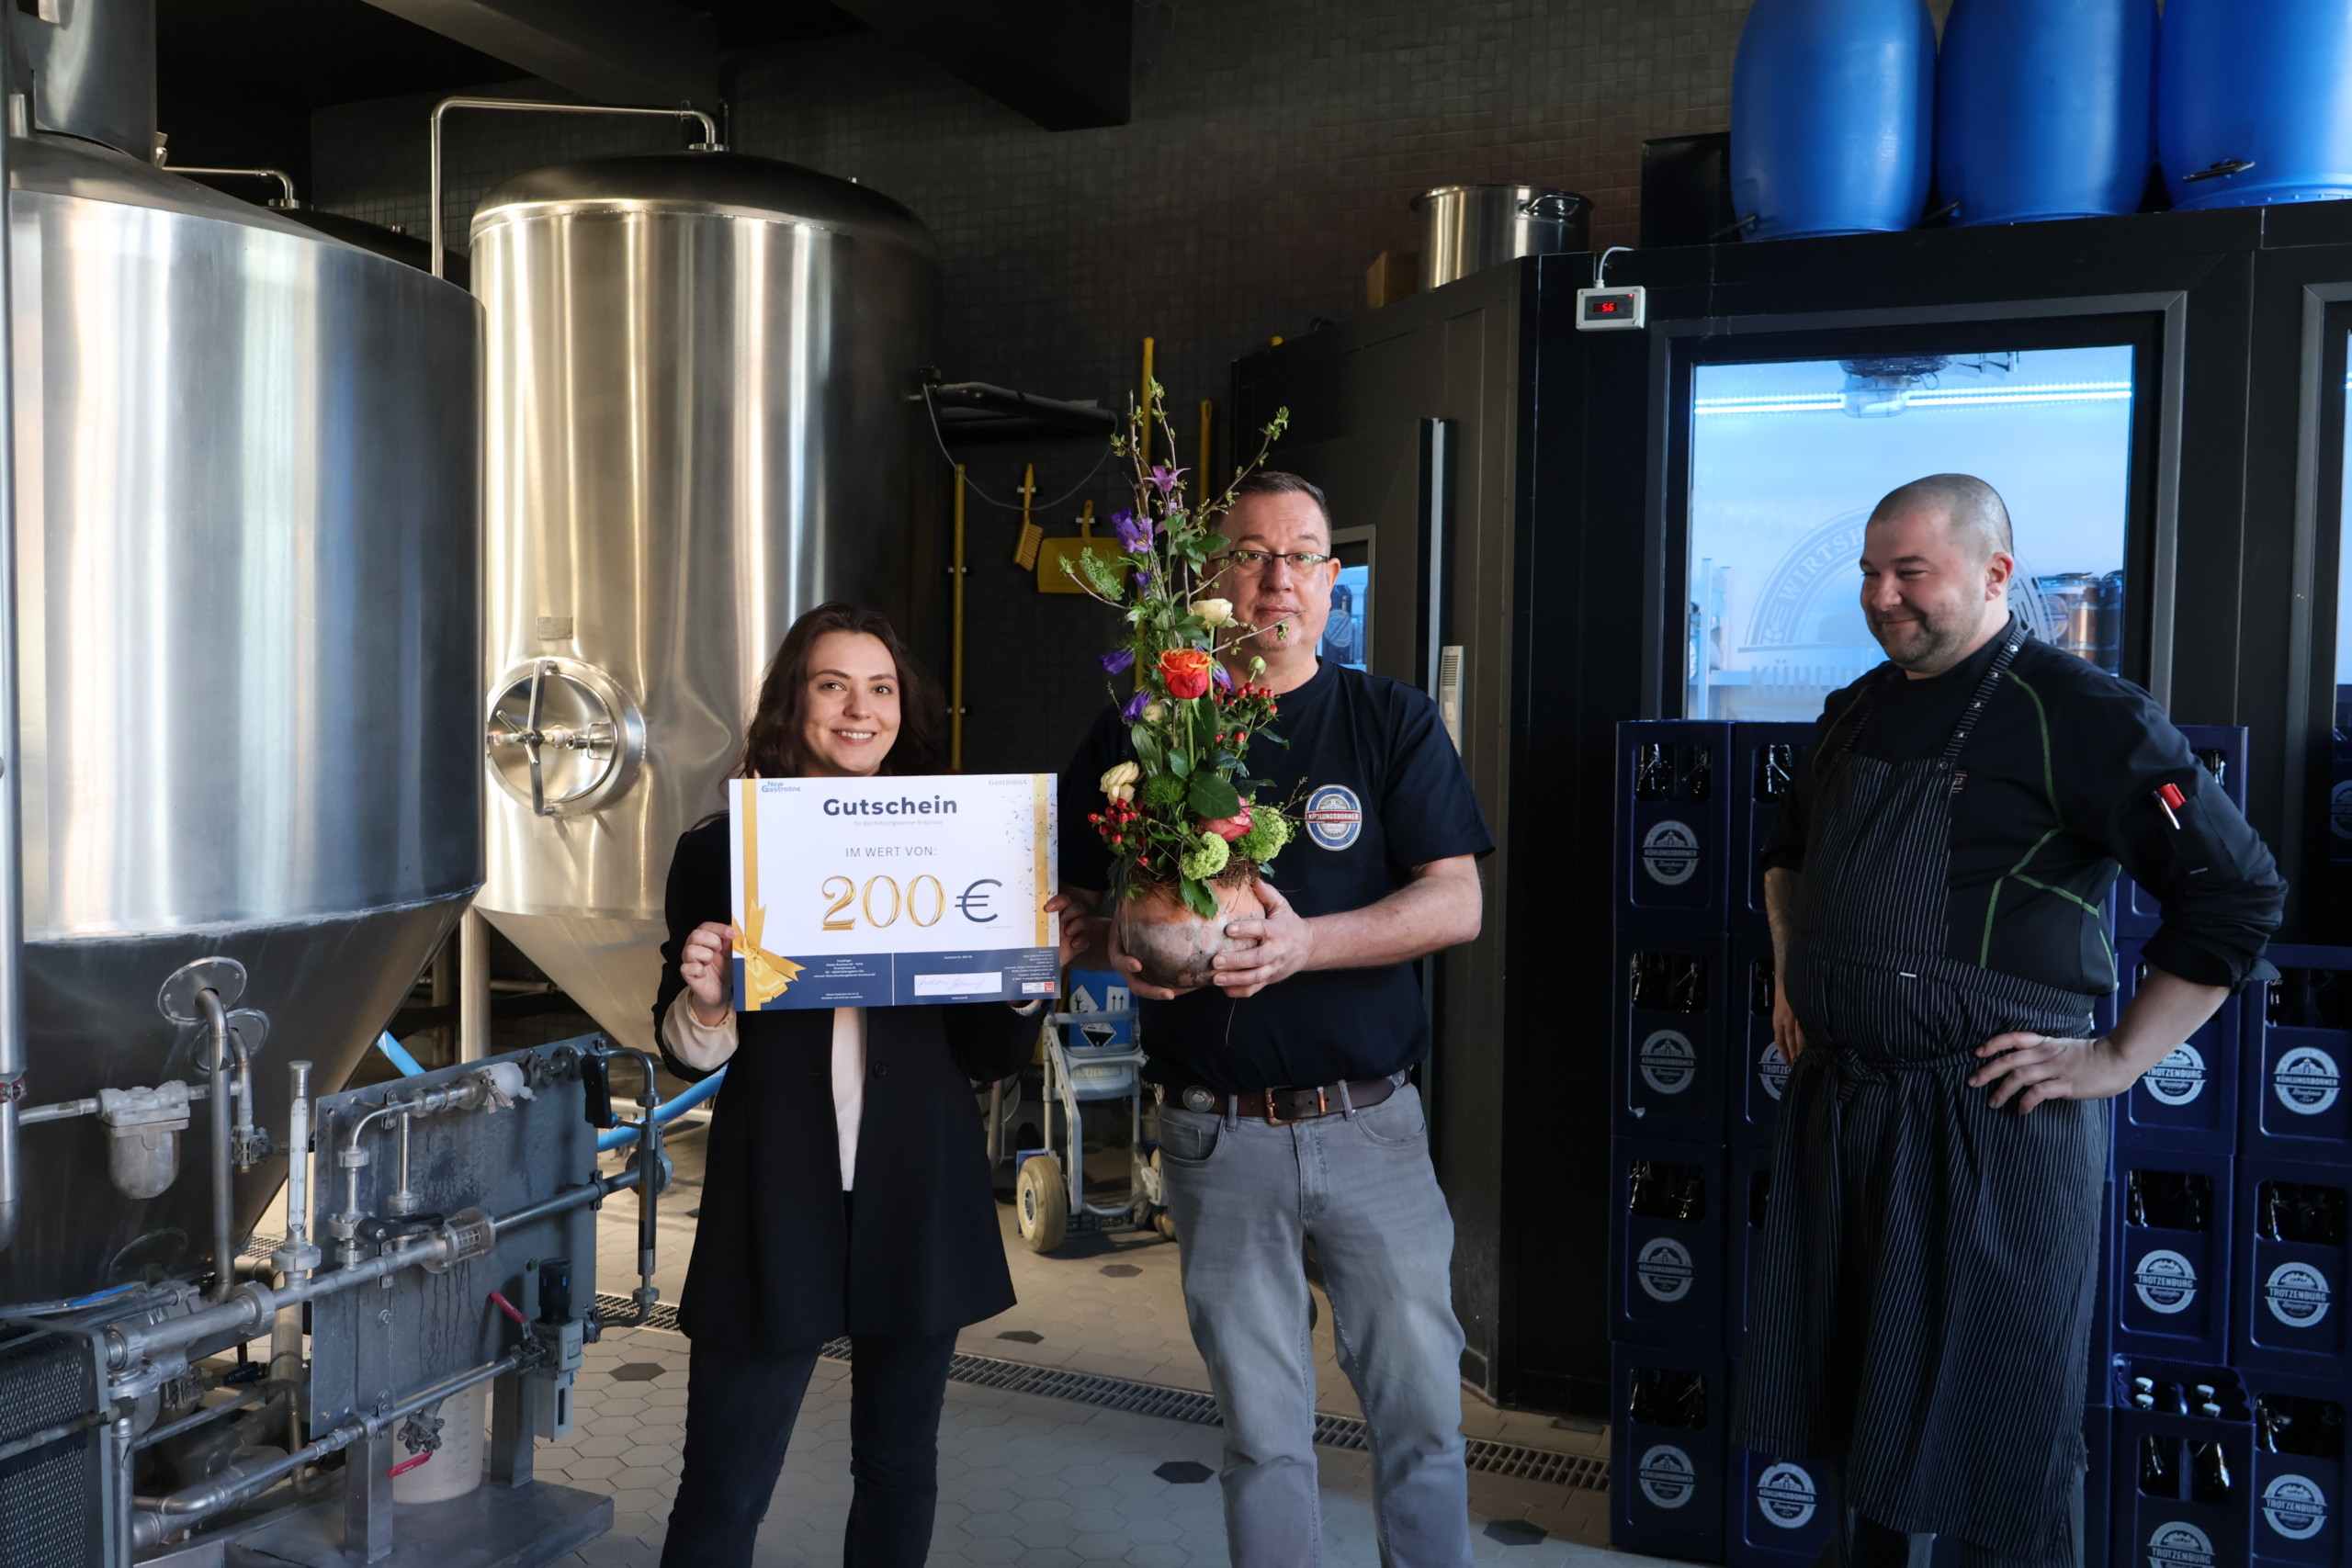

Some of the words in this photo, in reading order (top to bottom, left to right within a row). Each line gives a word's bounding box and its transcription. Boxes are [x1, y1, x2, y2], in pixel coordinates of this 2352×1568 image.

[1779, 526, 1866, 601] WIRTSH
[822, 795, 957, 816] Gutschein
[845, 847, 861, 857] IM
[865, 846, 901, 857] WERT
[905, 846, 937, 856] VON:
[821, 874, 946, 931] 200
[2147, 1067, 2202, 1078] TROTZENBURG
[2138, 1275, 2193, 1288] TROTZENBURG
[2269, 1288, 2327, 1302] TROTZENBURG
[2267, 1498, 2324, 1515] TROTZENBURG
[2152, 1547, 2211, 1564] TROTZENBURG
